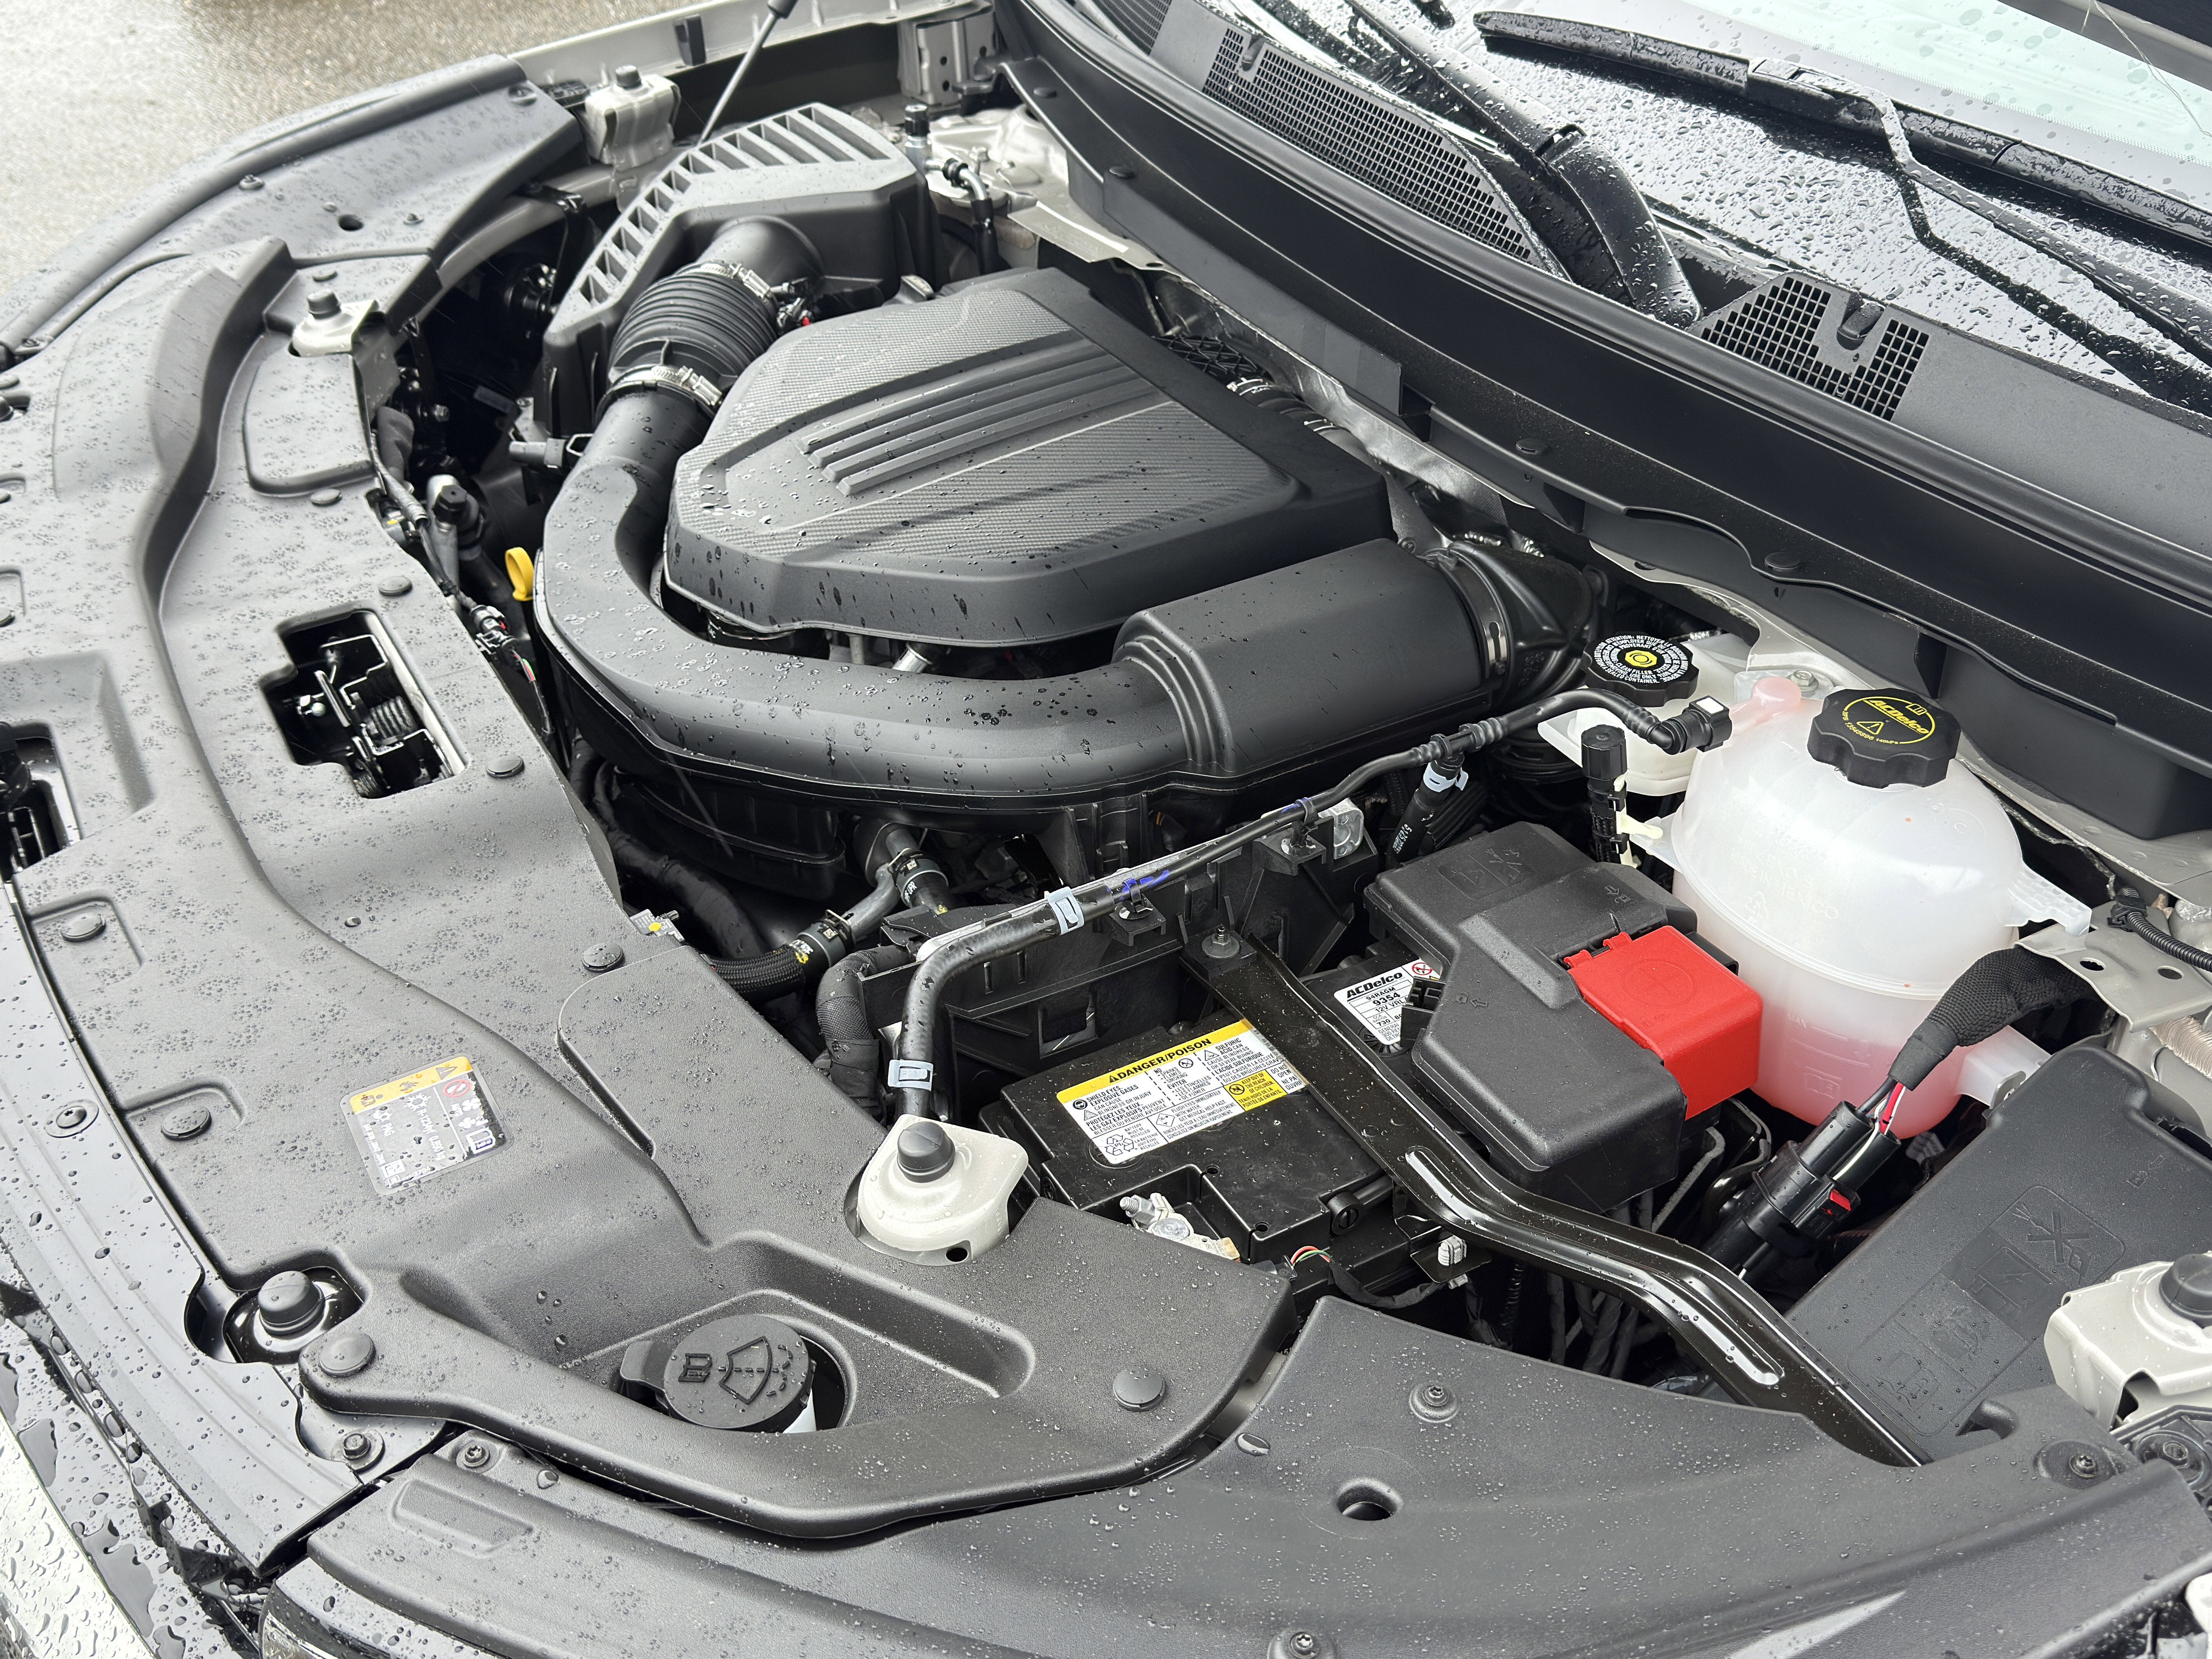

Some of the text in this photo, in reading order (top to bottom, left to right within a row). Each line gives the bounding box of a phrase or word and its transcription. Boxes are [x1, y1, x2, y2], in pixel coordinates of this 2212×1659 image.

[1605, 635, 1634, 644] ATTENTION:
[1637, 635, 1664, 644] NETTOYER
[1670, 646, 1687, 660] BOUCHON
[1664, 648, 1679, 659] LIQUIDE
[1602, 650, 1611, 661] BEFORE
[1610, 648, 1621, 663] WARNING:
[1662, 654, 1671, 663] BIDON
[1595, 658, 1606, 667] FROM
[1605, 668, 1625, 678] SEALED
[1605, 661, 1628, 676] REMOVING.
[1615, 663, 1632, 672] CLEAN
[1668, 664, 1679, 673] FREIN
[1869, 700, 1930, 734] ACDelco
[1844, 722, 1874, 740] 13546896
[1347, 973, 1402, 998] ACDelco
[1366, 987, 1396, 1000] 94RAGM
[1373, 992, 1400, 1005] 9354
[1215, 1038, 1241, 1051] SULFURIC
[1117, 1039, 1212, 1079] DANGER/POISON
[1207, 1046, 1249, 1065] CAUSE BLINDNESS
[1218, 1057, 1237, 1066] SEVERE
[1214, 1052, 1264, 1074] L'ACIDE SULFURIQUE
[1232, 1064, 1252, 1073] CAUSER
[1258, 1053, 1275, 1063] CÉCITÉ
[1240, 1063, 1266, 1076] BRÛLURES
[1160, 1067, 1178, 1076] SPARKS
[1163, 1070, 1181, 1079] FLAMES
[1166, 1073, 1188, 1083] SMOKING
[1167, 1079, 1187, 1089] ÉVITER
[1184, 1076, 1211, 1089] ÉTINCELLES
[1187, 1081, 1210, 1092] FLAMMES
[1254, 1081, 1274, 1091] CHILDREN.
[1087, 1086, 1123, 1102] SHIELD EYES.
[1090, 1085, 1138, 1106] EXPLOSIVE GASES
[1188, 1088, 1206, 1097] FUMER
[1242, 1099, 1259, 1108] PORTÉE
[1263, 1090, 1283, 1099] ENFANTS.
[1097, 1102, 1125, 1115] BLINDNESS
[1133, 1091, 1151, 1101] INJURY
[1105, 1098, 1122, 1106] CAUSE
[1171, 1105, 1185, 1113] FLUSH
[1195, 1091, 1221, 1103] IMMEDIATELY
[450, 1103, 463, 1117] AUTO
[1086, 1112, 1115, 1127] PROTÉGEZ
[1125, 1102, 1143, 1110] YEUX.
[1112, 1108, 1142, 1122] EXPLOSIFS
[1142, 1099, 1164, 1110] PEUVENT
[1187, 1109, 1206, 1118] MEDICAL
[1094, 1124, 1116, 1135] BLESSER
[1124, 1113, 1144, 1123] RENDRE
[1145, 1103, 1167, 1115] AVEUGLE.
[380, 1123, 395, 1137] PAG
[1125, 1123, 1141, 1132] BATTERY
[1130, 1129, 1150, 1138] RECYCLED
[1167, 1128, 1188, 1139] CONSULTEZ
[1193, 1119, 1210, 1128] MÉDECIN
[416, 1108, 437, 1135] R-1234yf
[435, 1151, 446, 1161] kg
[1140, 1133, 1158, 1141] BATTERIE
